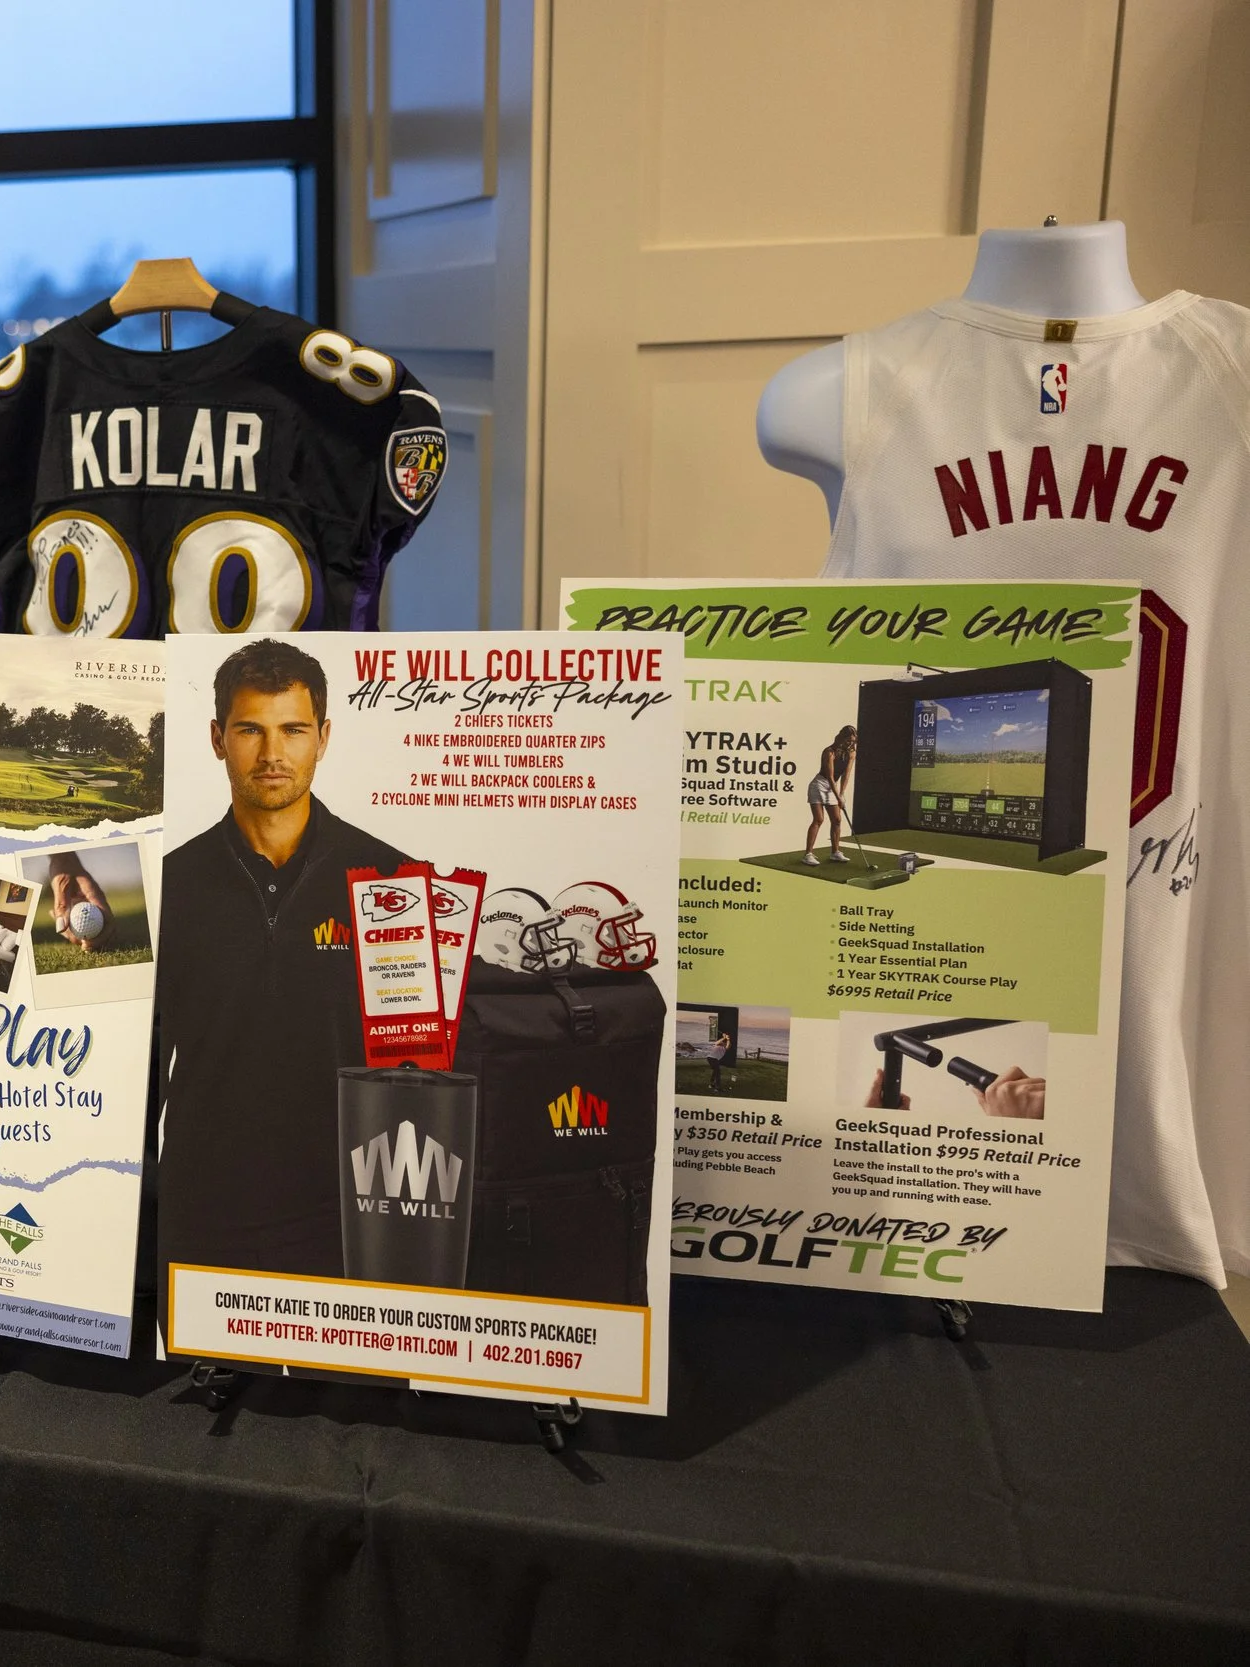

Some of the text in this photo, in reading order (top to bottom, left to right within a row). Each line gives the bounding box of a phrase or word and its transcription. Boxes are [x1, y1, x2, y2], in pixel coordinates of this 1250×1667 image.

[1044, 403, 1057, 411] NBA
[400, 433, 444, 446] RAVENS
[70, 406, 263, 492] KOLAR
[934, 445, 1189, 539] NIANG
[594, 603, 1103, 647] PRACTICE YOUR GAME
[355, 649, 662, 681] WE WILL COLLECTIVE
[348, 676, 672, 720] All-Star Sports Package
[465, 714, 553, 728] CHIEFS TICKETS
[918, 713, 935, 728] 194
[414, 734, 605, 749] NIKE EMBROIDERED QUARTER ZIPS
[504, 755, 564, 768] TUMBLERS
[716, 755, 797, 776] Studio
[471, 774, 583, 789] BACKPACK COOLERS
[729, 779, 778, 792] Install
[382, 792, 637, 810] CYCLONE HELMETS DISPLAY CASES
[709, 794, 777, 808] Software
[722, 900, 768, 911] Monitor
[840, 905, 894, 919] Ball Tray
[480, 910, 524, 925] Cyclones
[364, 925, 425, 944] CHIEFS
[839, 921, 915, 937] Side Netting
[838, 937, 985, 954] GeekSquad Installation
[400, 962, 427, 970] RAIDERS
[848, 953, 967, 970] Year Essential Plan
[391, 971, 415, 979] RAVENS
[879, 971, 1018, 990] SKYTRAK Course Play
[827, 984, 952, 1002] $6995 Retail Price
[369, 1023, 439, 1035] ADMIT ONE
[55, 1081, 102, 1117] Stay
[554, 1127, 608, 1137] WE WILL
[835, 1118, 1044, 1145] GeekSquad Professional
[936, 1144, 980, 1160] $995
[356, 1198, 455, 1219] WE WILL
[807, 1212, 1008, 1252] DONATED BY
[670, 1225, 966, 1283] GOLFTEC
[216, 1292, 596, 1345] CONTACT KATIE ORDER YOUR CUSTOM SPORTS PACKAGE!
[322, 1327, 582, 1369] KPOTTER@1RTI.COM 402.201.6967
